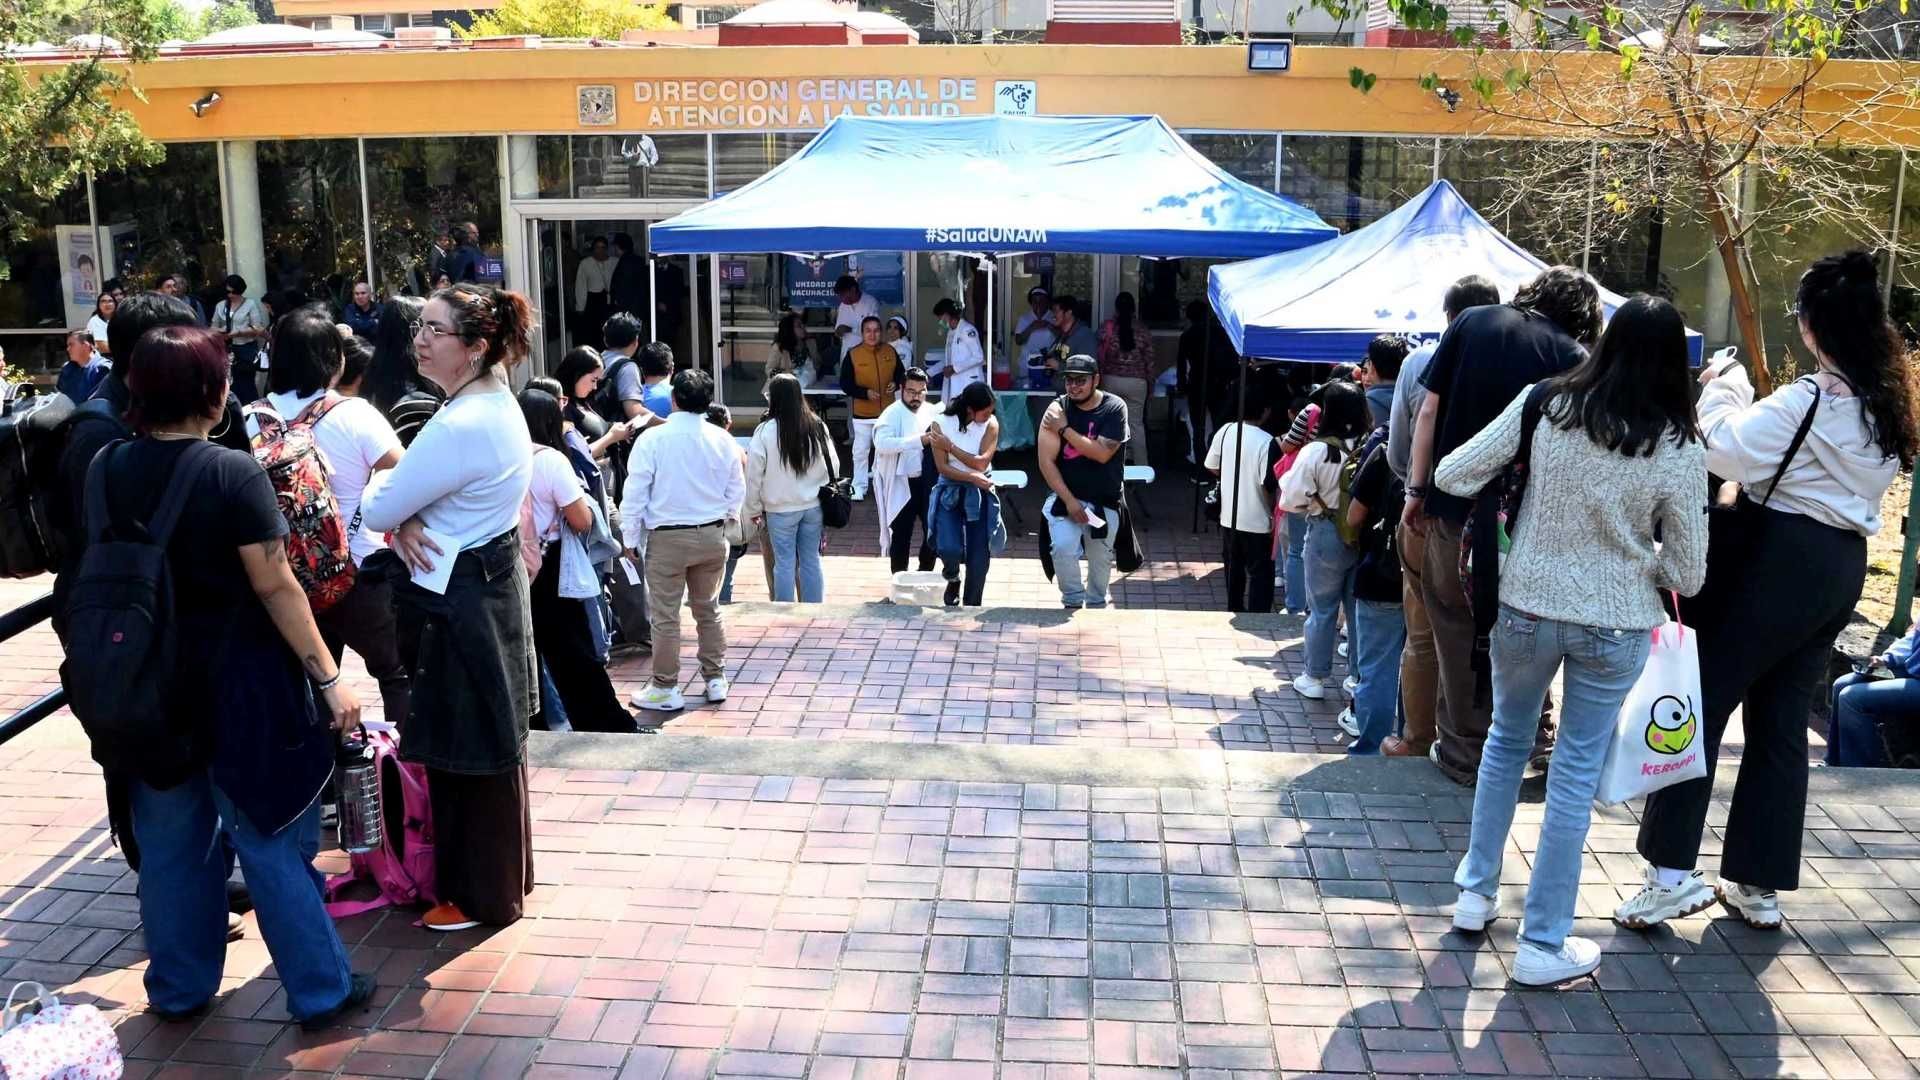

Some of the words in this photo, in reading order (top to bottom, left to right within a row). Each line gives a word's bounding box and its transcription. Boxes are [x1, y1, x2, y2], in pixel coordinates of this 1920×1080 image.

[633, 80, 789, 102] DIRECCION
[798, 79, 929, 101] GENERAL
[939, 79, 977, 101] DE
[648, 105, 789, 126] ATENCION
[797, 104, 816, 125] A
[925, 227, 1047, 243] #SaludUNAM
[795, 280, 827, 288] UNIDAD
[791, 288, 841, 297] VACUNACIÓ
